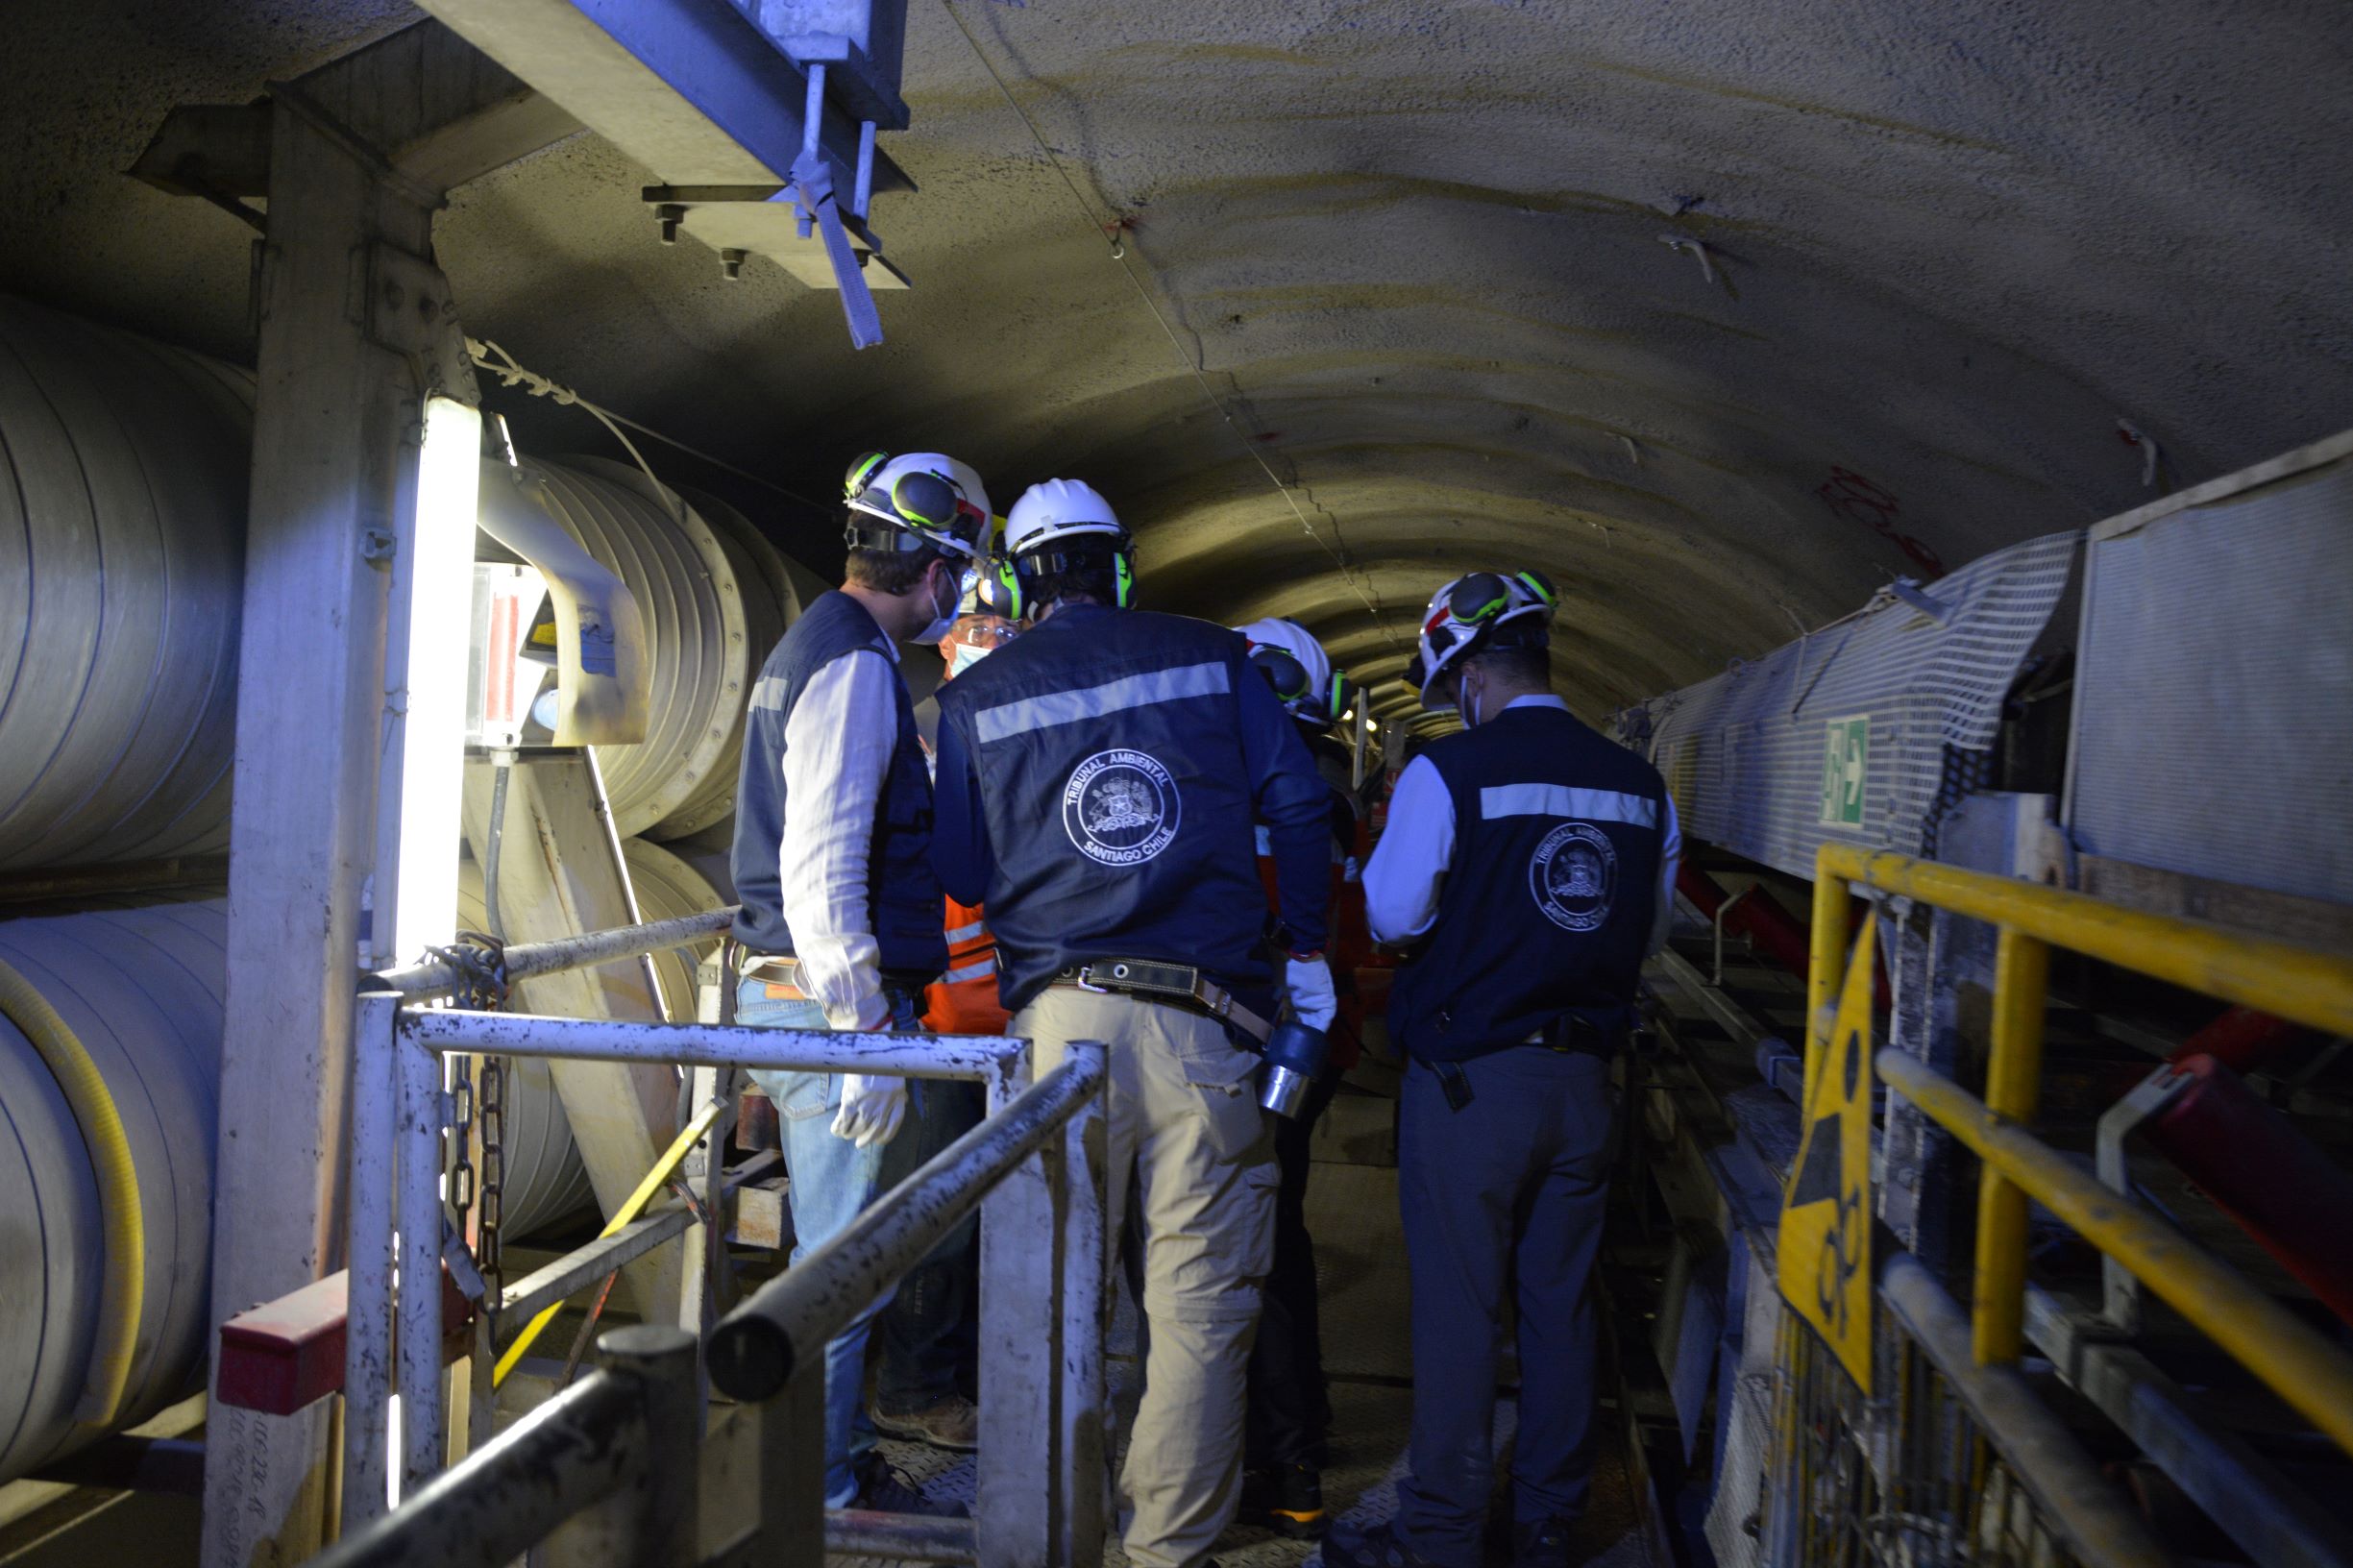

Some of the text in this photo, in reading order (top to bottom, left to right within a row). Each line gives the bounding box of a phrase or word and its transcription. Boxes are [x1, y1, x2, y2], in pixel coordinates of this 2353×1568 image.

[1066, 752, 1169, 806] TRIBUNAL AMBIENTAL
[1083, 826, 1173, 863] SANTIAGO CHILE
